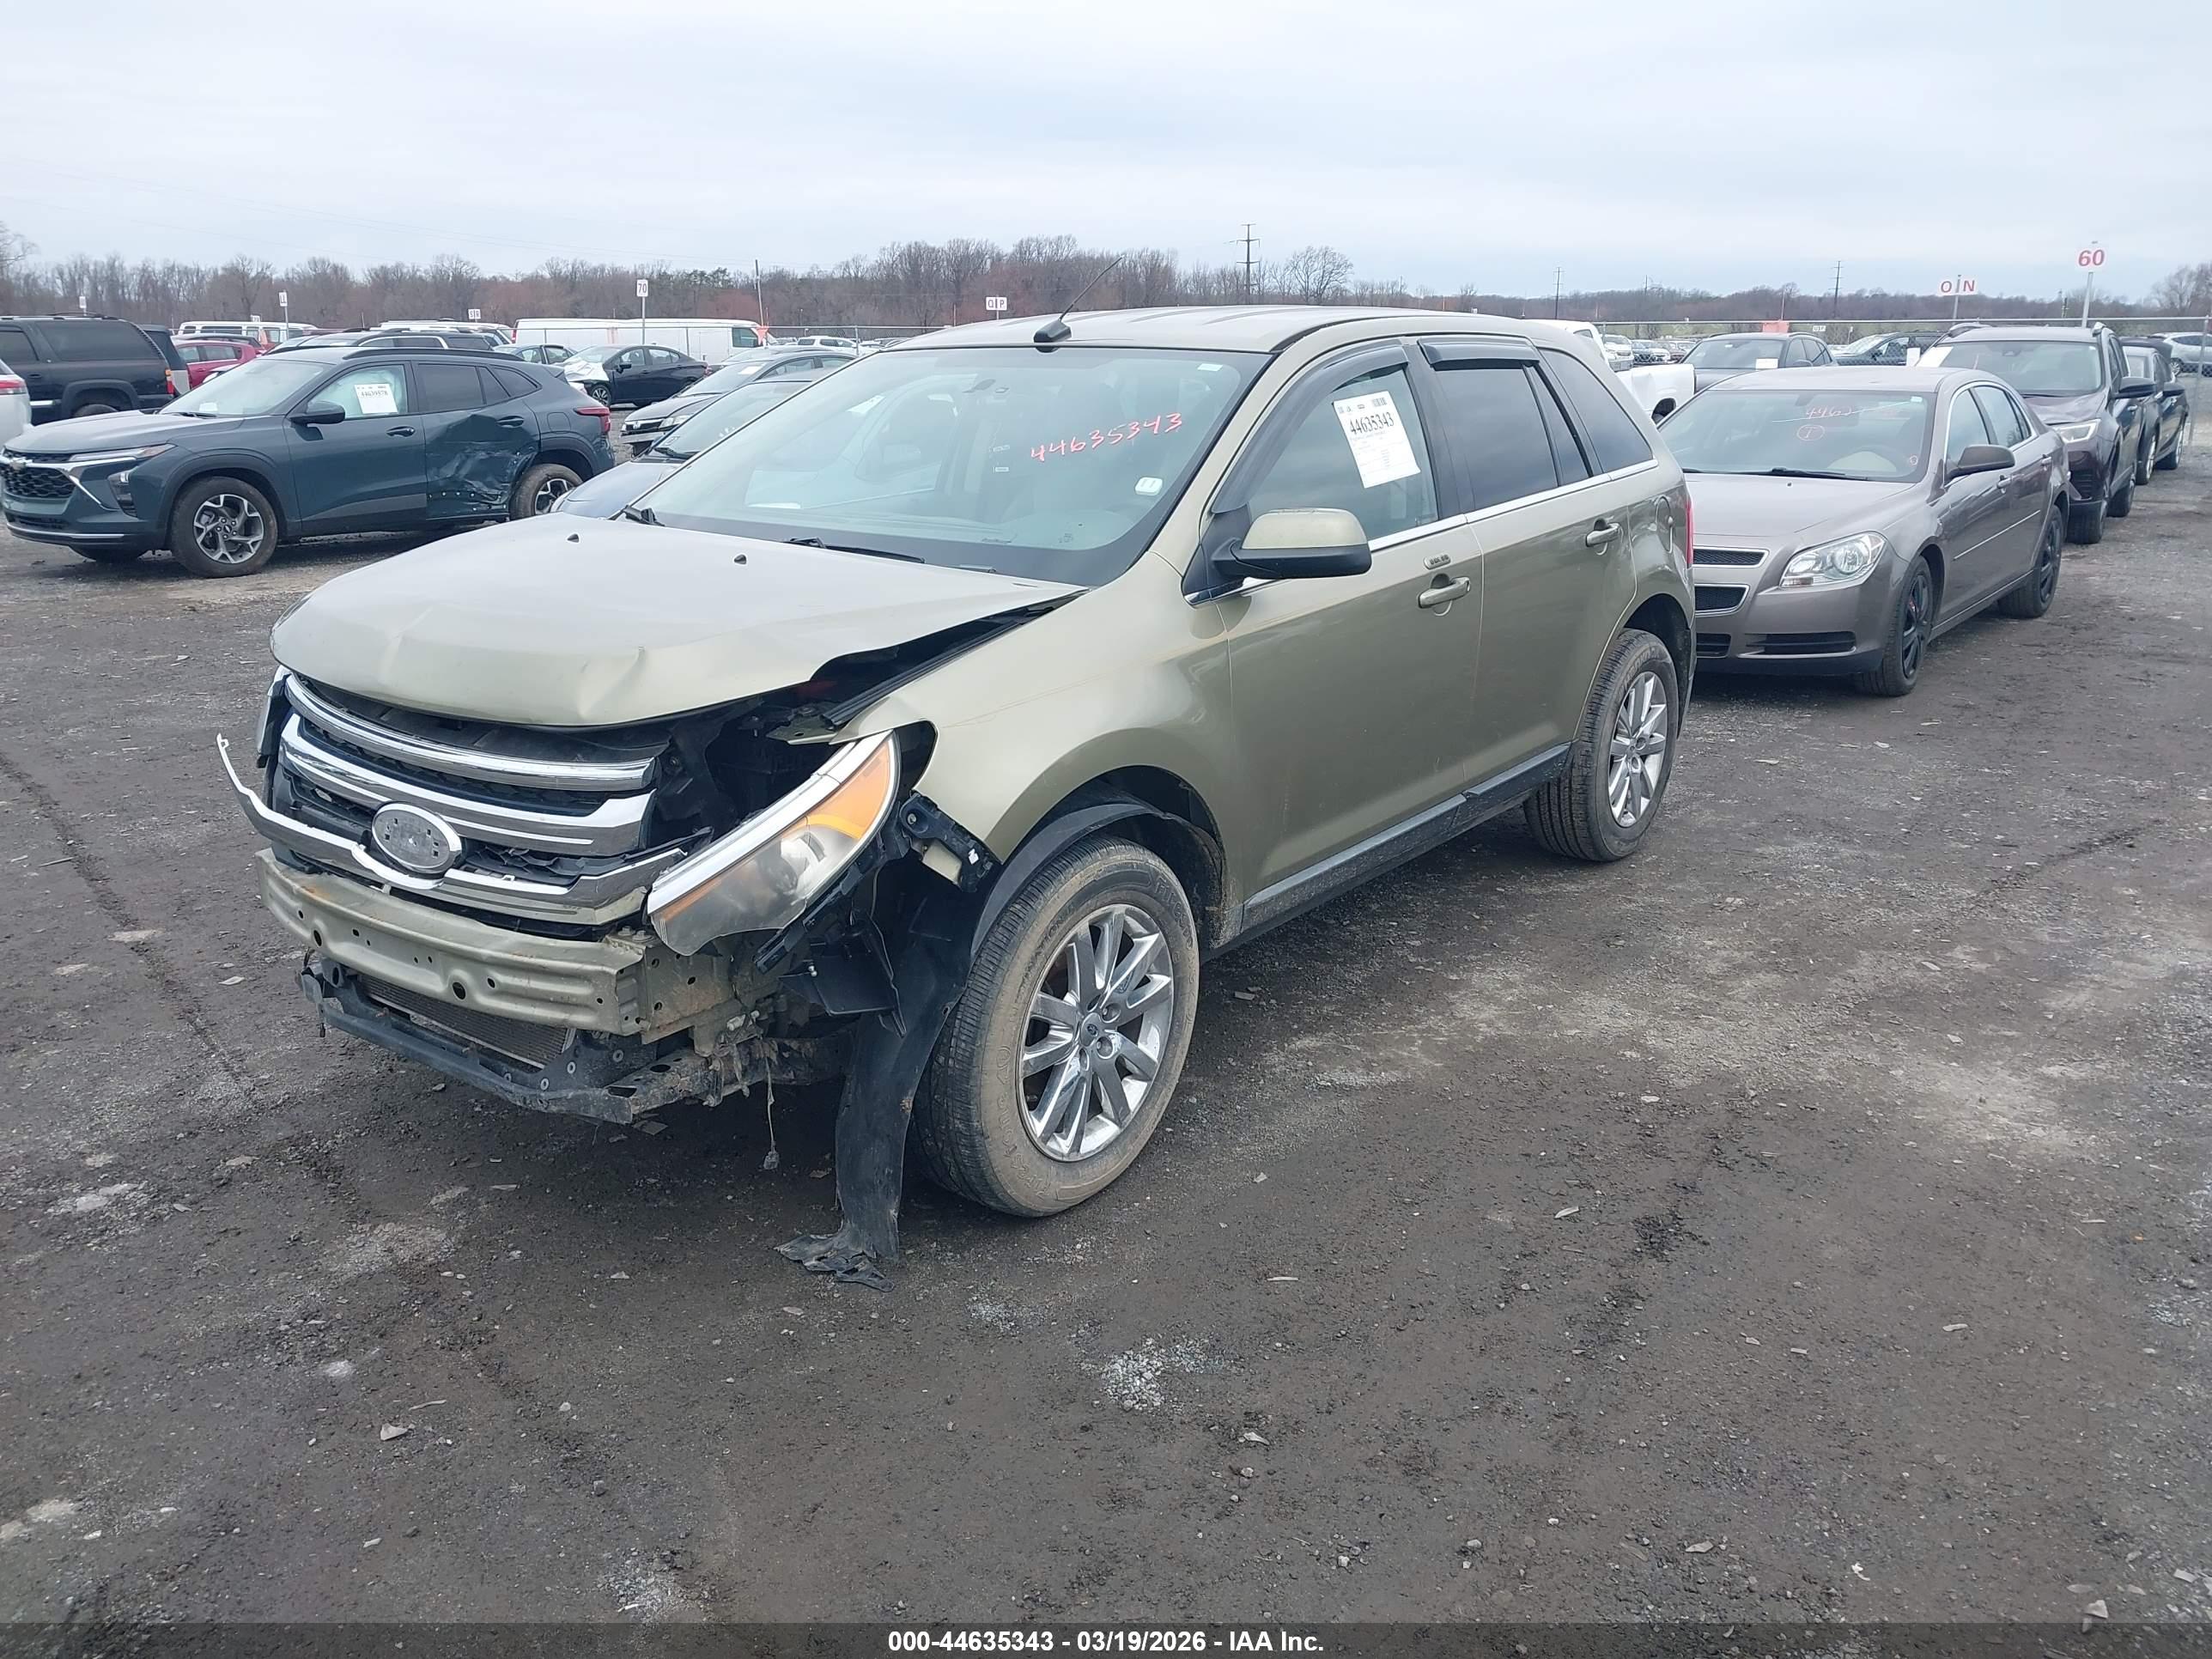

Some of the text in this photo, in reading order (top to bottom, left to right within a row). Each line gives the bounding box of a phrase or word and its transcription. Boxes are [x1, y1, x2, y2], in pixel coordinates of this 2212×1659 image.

[2078, 249, 2106, 267] 60
[638, 283, 647, 293] 70
[1963, 280, 1975, 292] N
[1350, 411, 1395, 434] 44635343
[1030, 412, 1182, 462] 44635343
